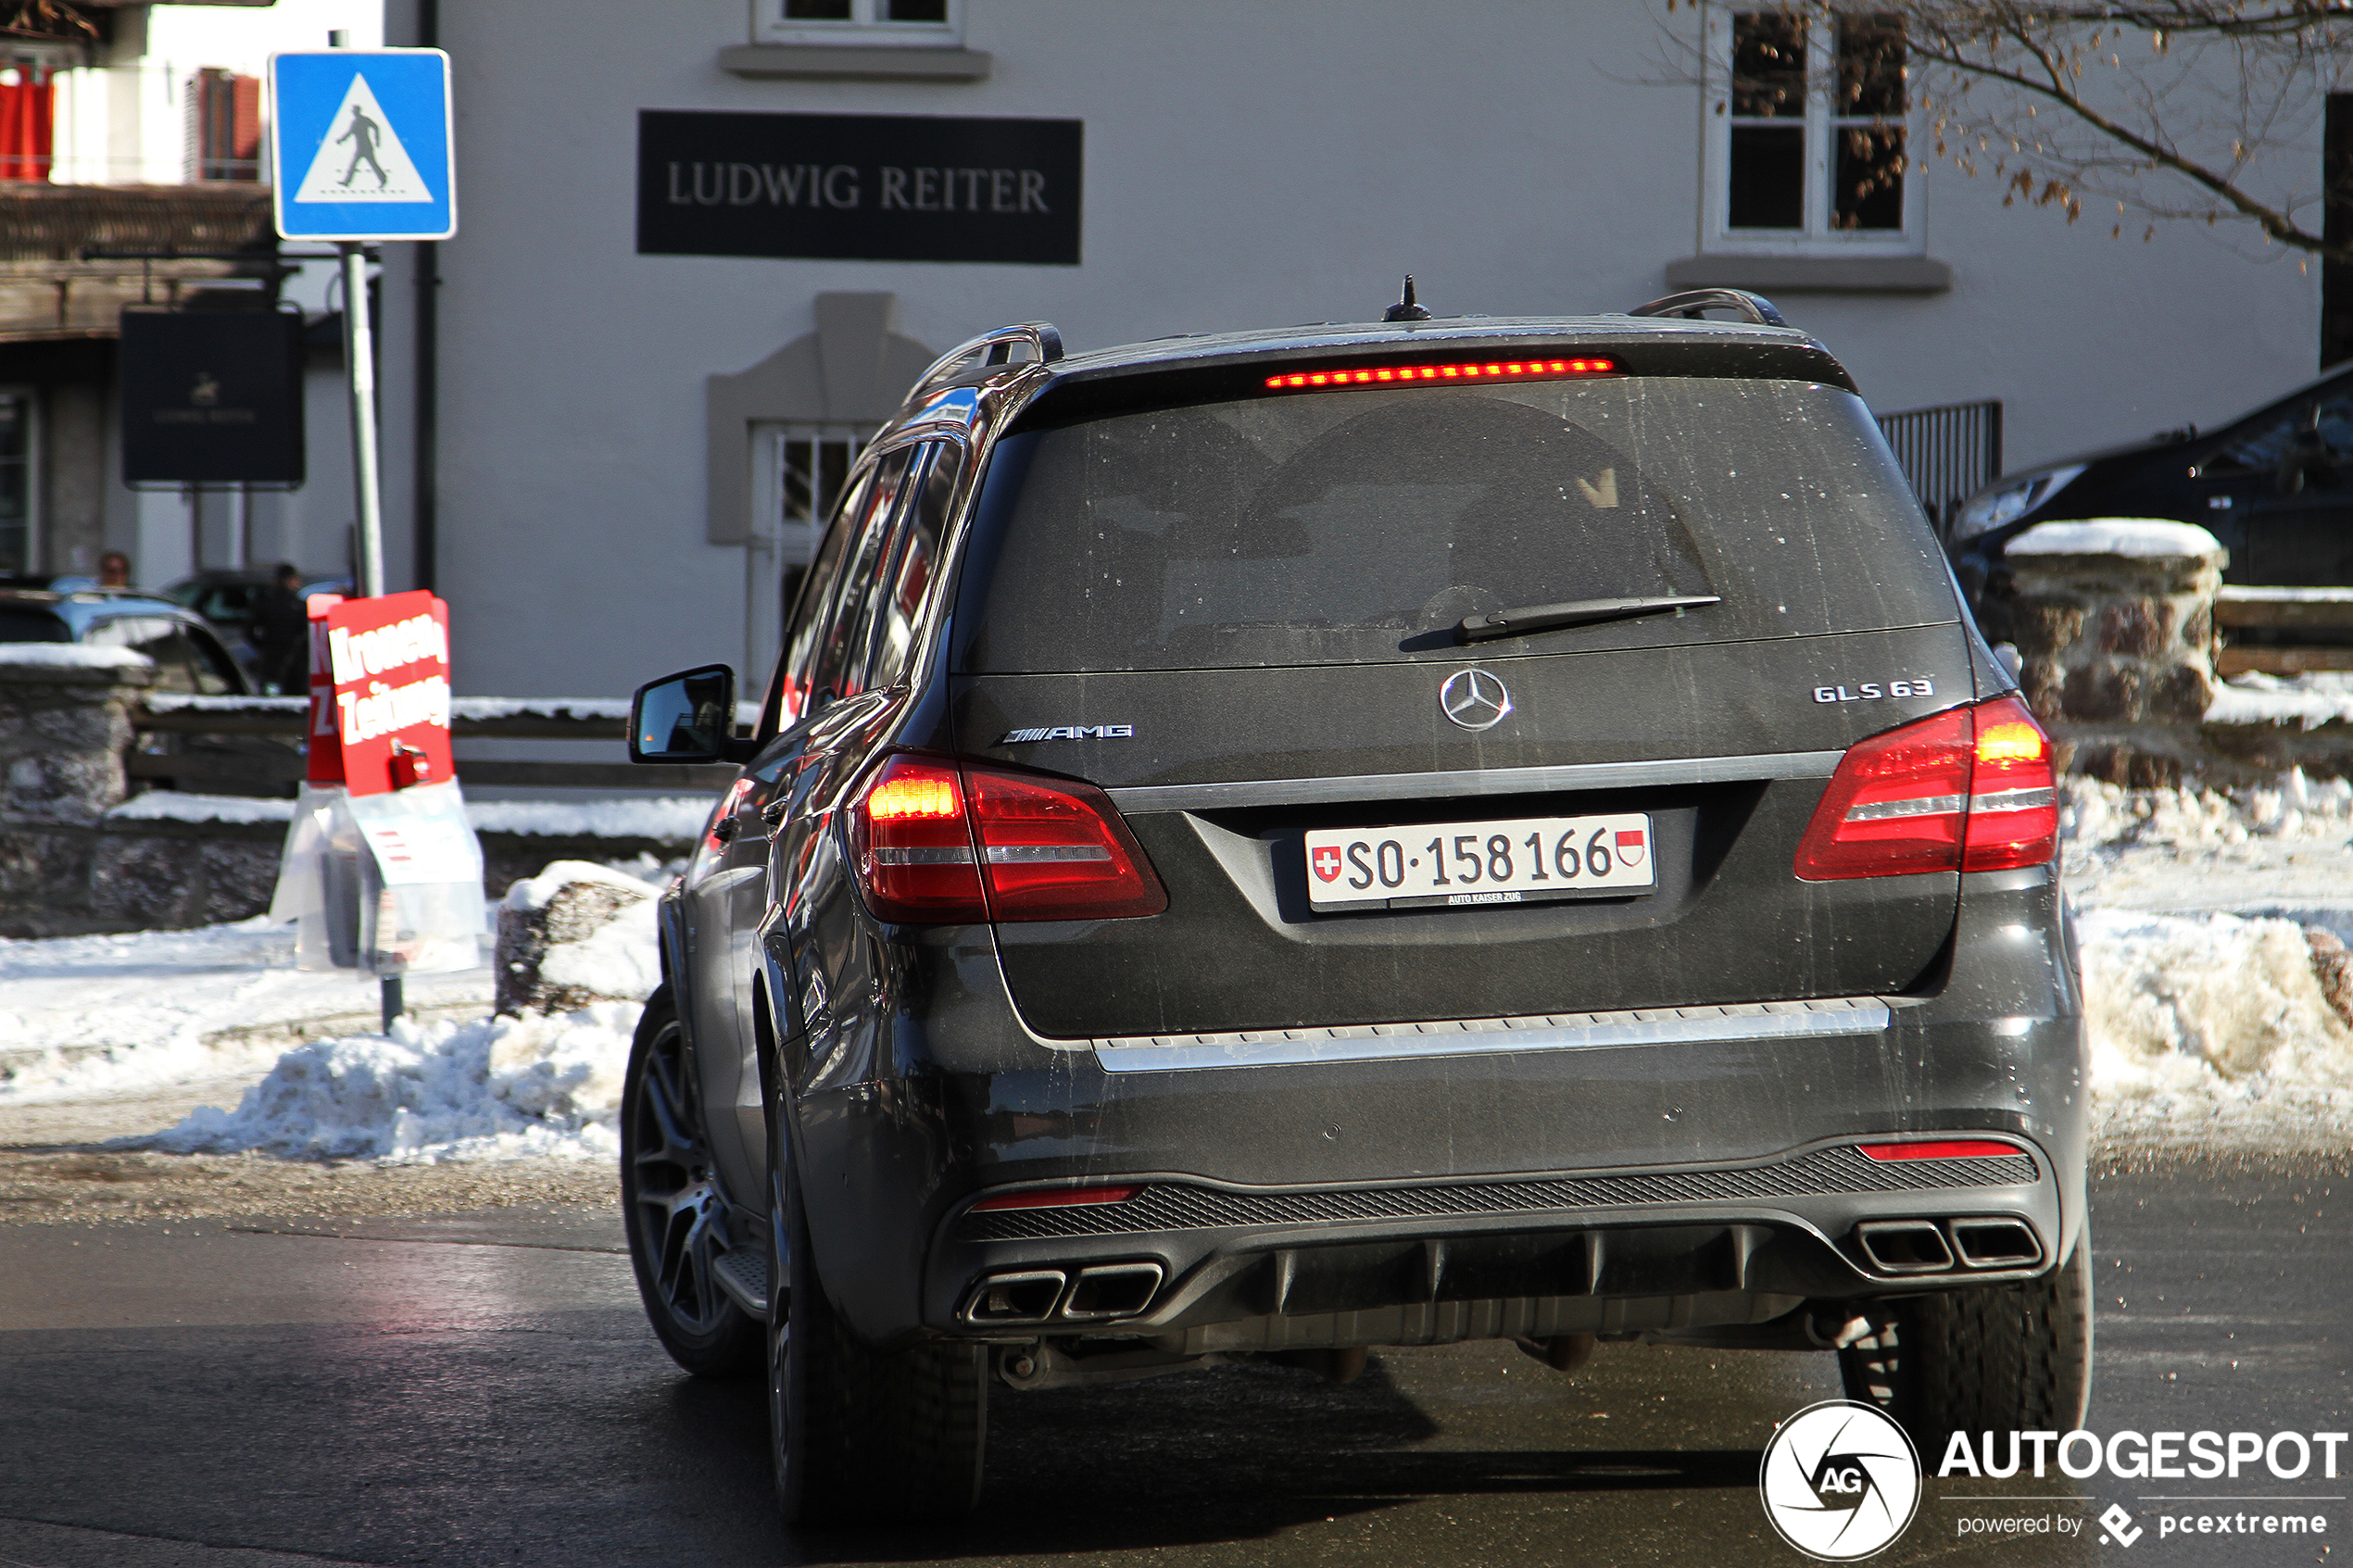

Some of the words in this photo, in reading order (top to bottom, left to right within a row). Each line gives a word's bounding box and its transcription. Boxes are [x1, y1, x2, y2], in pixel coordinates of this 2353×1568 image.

[668, 161, 860, 209] LUDWIG
[880, 165, 1051, 214] REITER
[328, 613, 436, 685] Kronen
[336, 674, 446, 746] Zeitung
[1813, 683, 1883, 704] GLS
[1889, 679, 1934, 697] 63
[1043, 724, 1132, 741] AMG
[1448, 894, 1471, 905] AUTO
[1472, 892, 1503, 903] KAISER
[1504, 891, 1522, 901] ZUG
